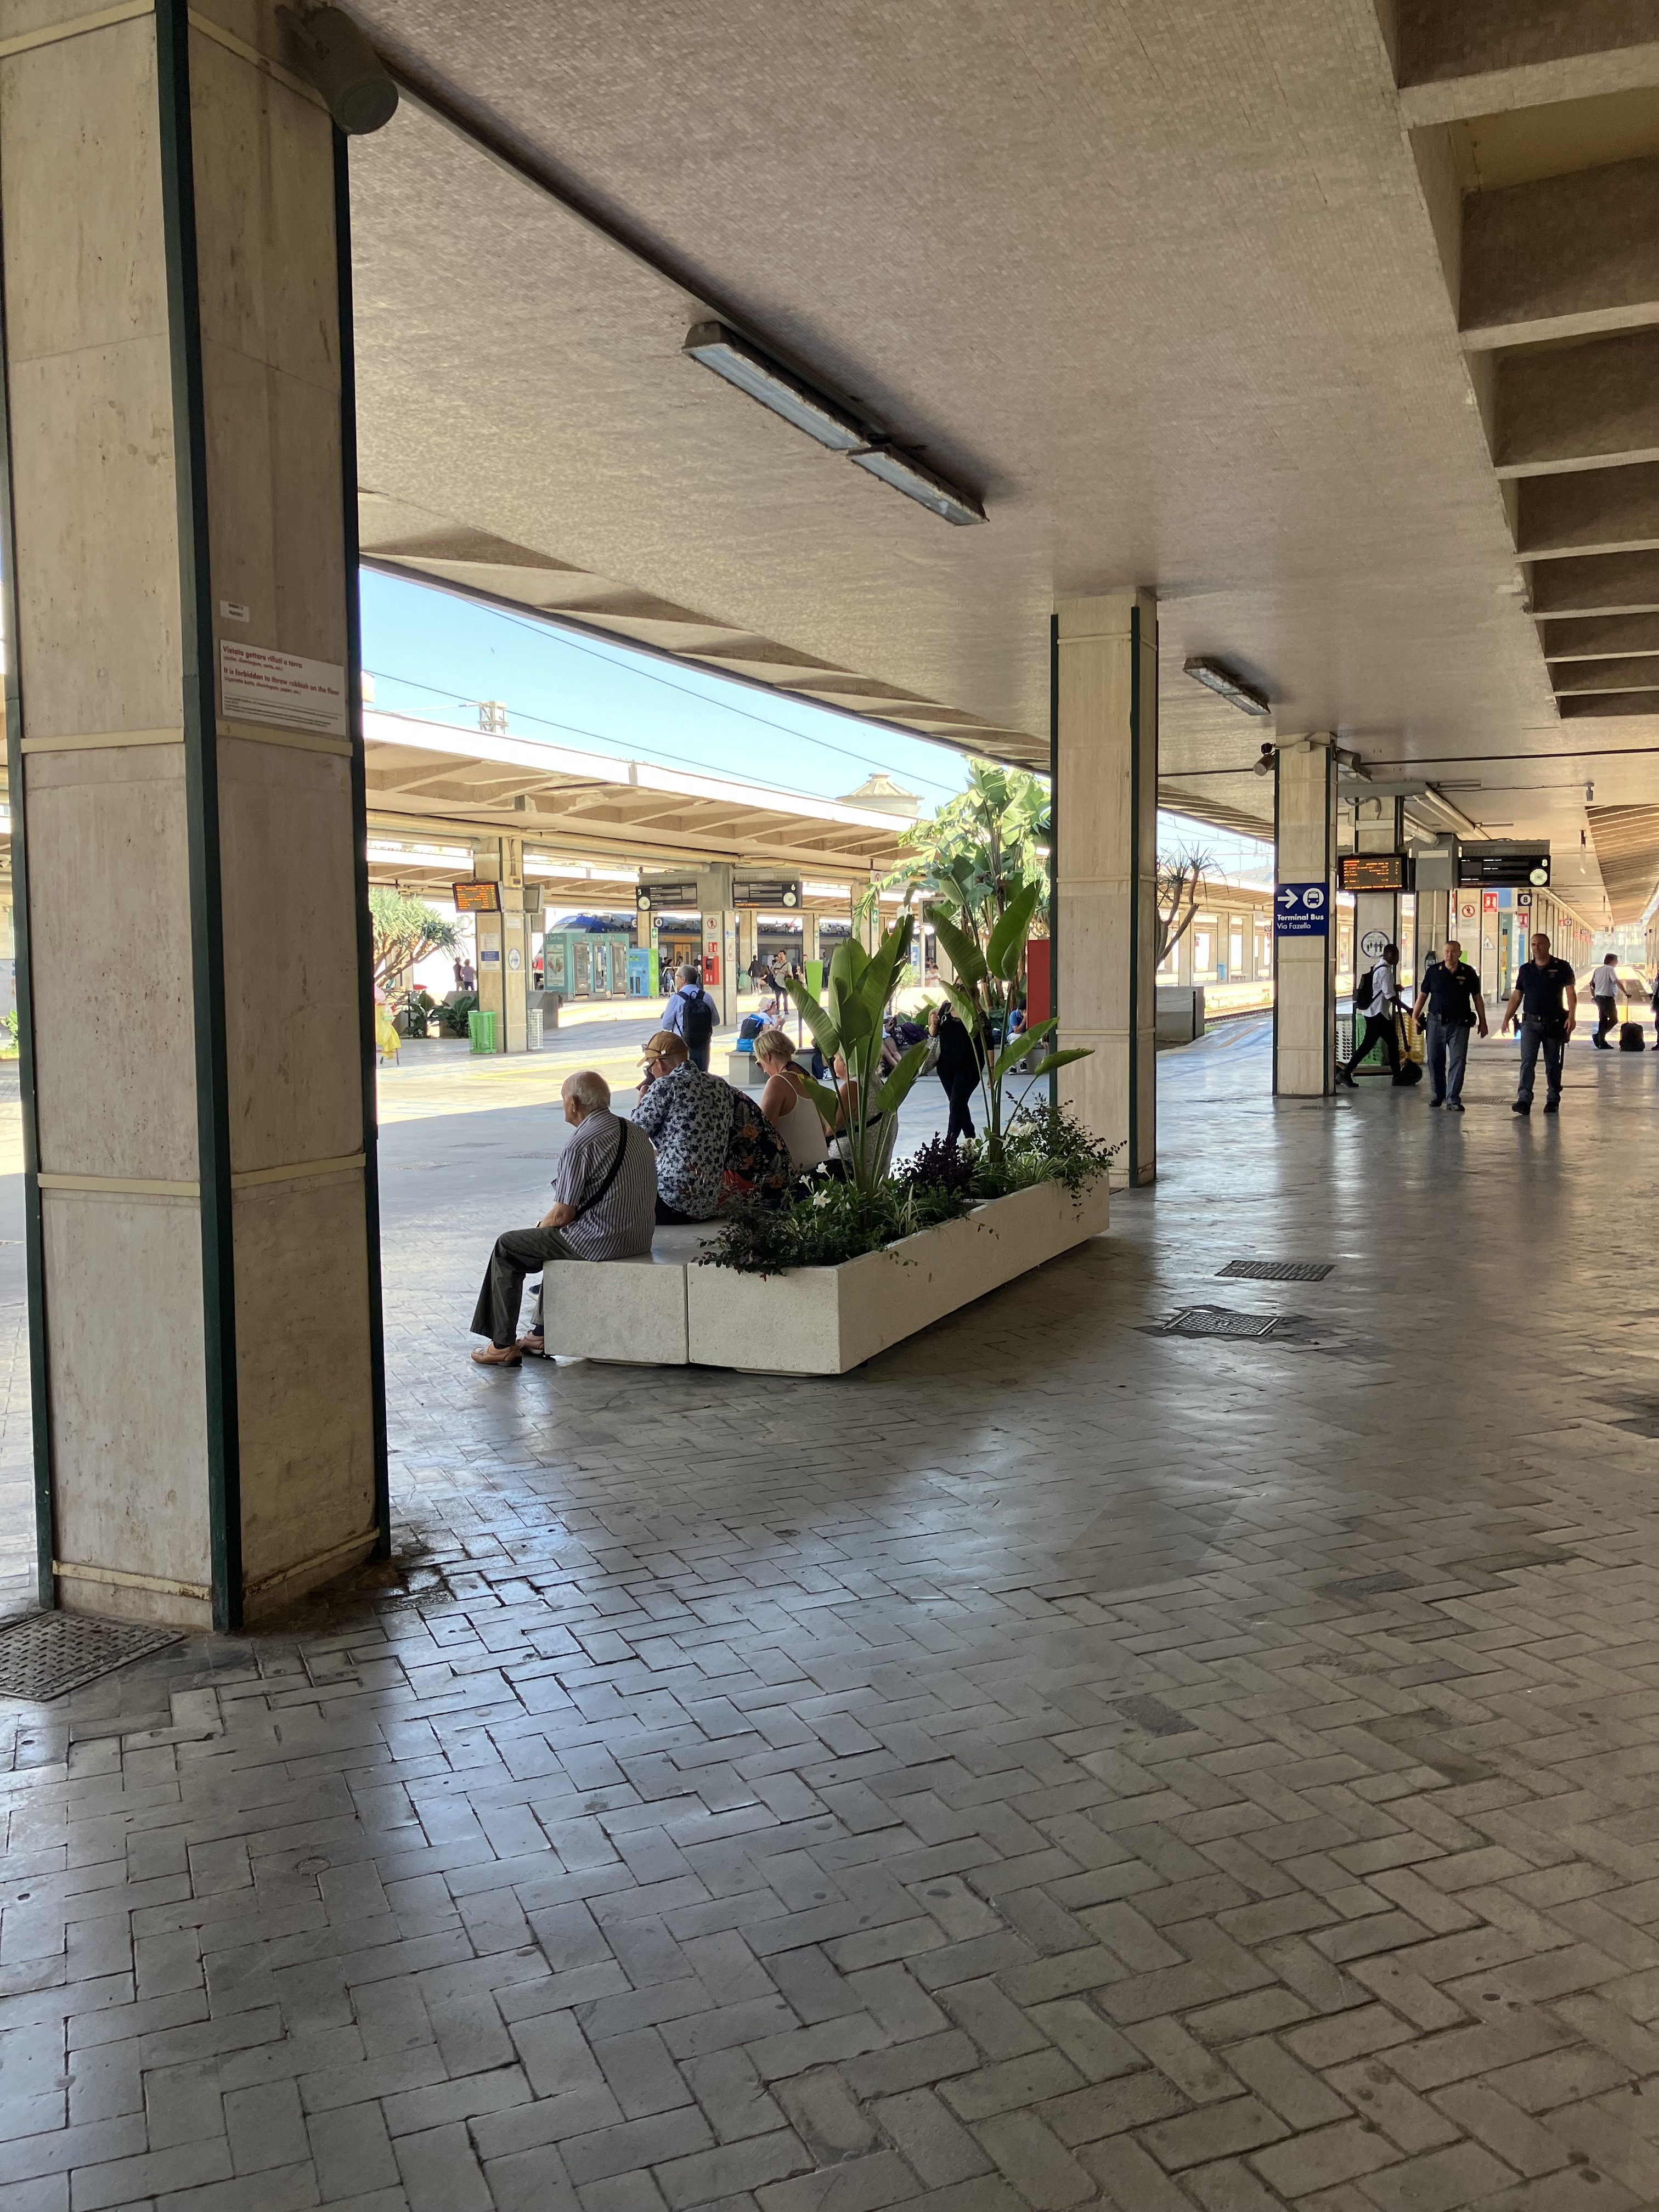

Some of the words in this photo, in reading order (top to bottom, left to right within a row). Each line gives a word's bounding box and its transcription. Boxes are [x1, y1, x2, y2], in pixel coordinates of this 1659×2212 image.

[223, 645, 244, 656] Vietato
[245, 652, 267, 661] gettare
[235, 668, 263, 681] forbidden
[272, 676, 287, 685] throw
[289, 680, 309, 690] rubbish
[318, 685, 326, 693] the
[327, 687, 340, 696] floor
[1541, 859, 1548, 867] 8
